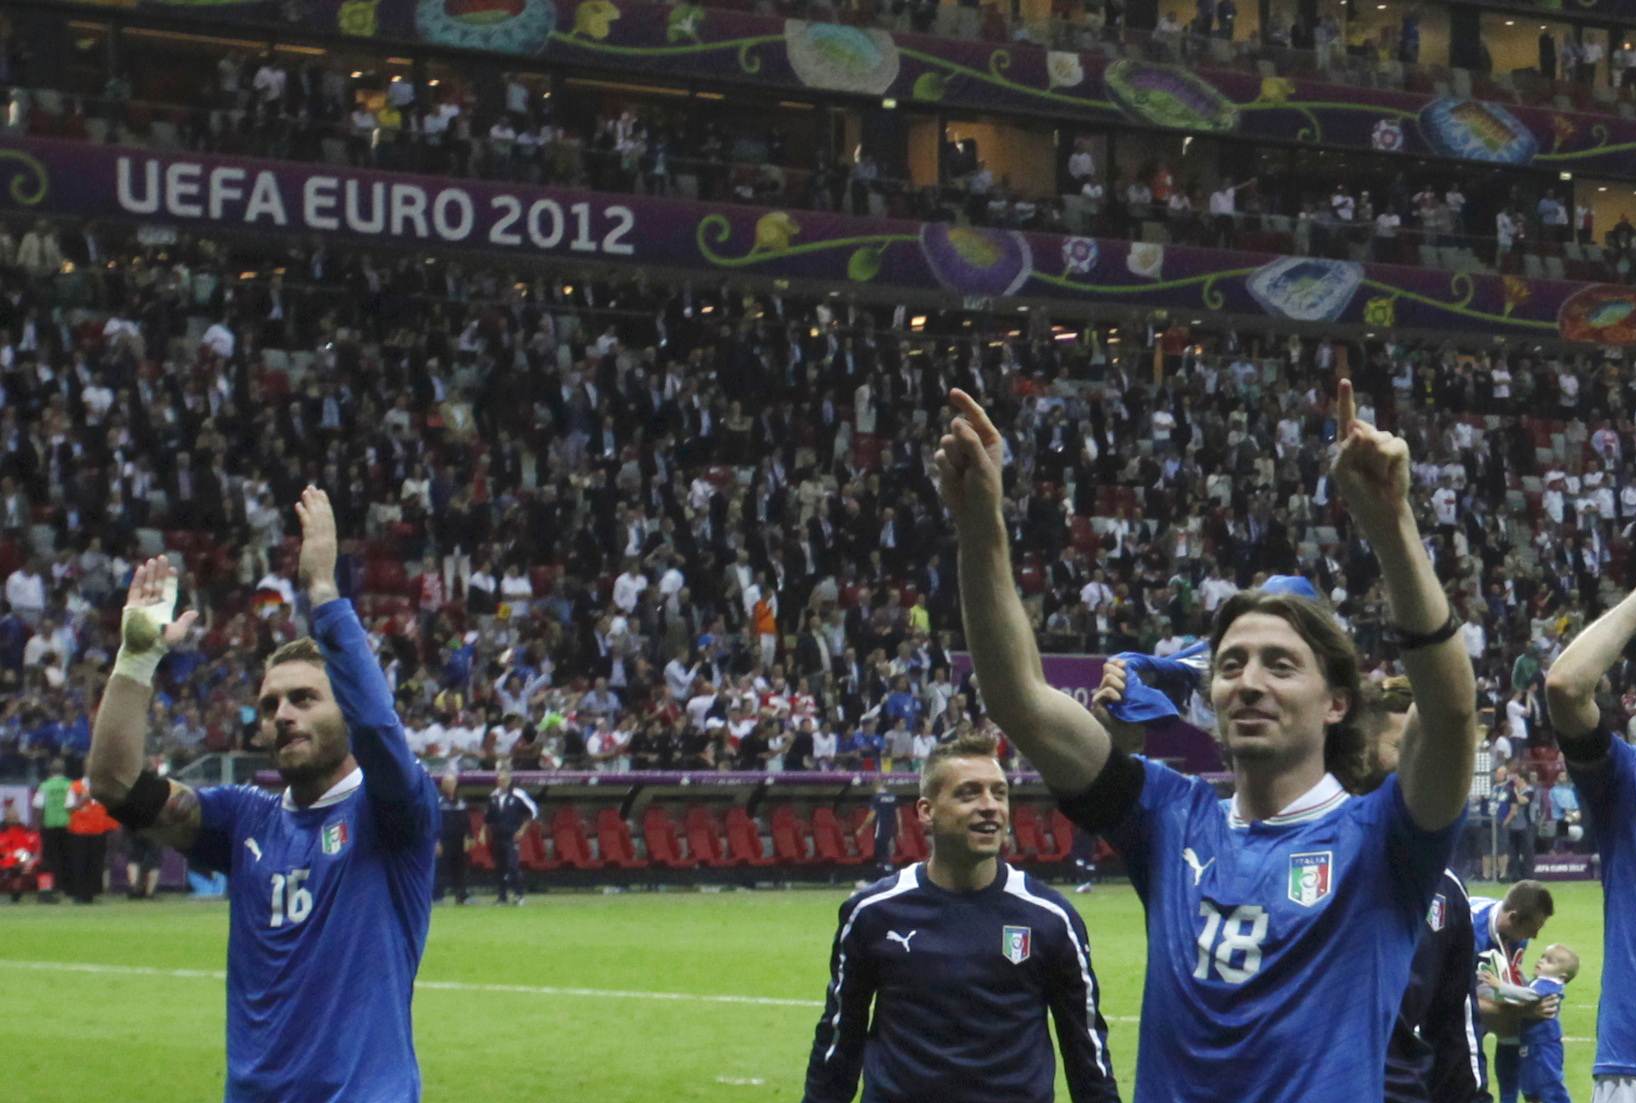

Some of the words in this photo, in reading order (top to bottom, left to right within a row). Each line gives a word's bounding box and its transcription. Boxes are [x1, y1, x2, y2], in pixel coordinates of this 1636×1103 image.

[117, 157, 288, 225] UEFA
[303, 176, 474, 241] EURO
[489, 195, 635, 255] 2012
[269, 869, 313, 927] 16
[1193, 901, 1269, 984] 18
